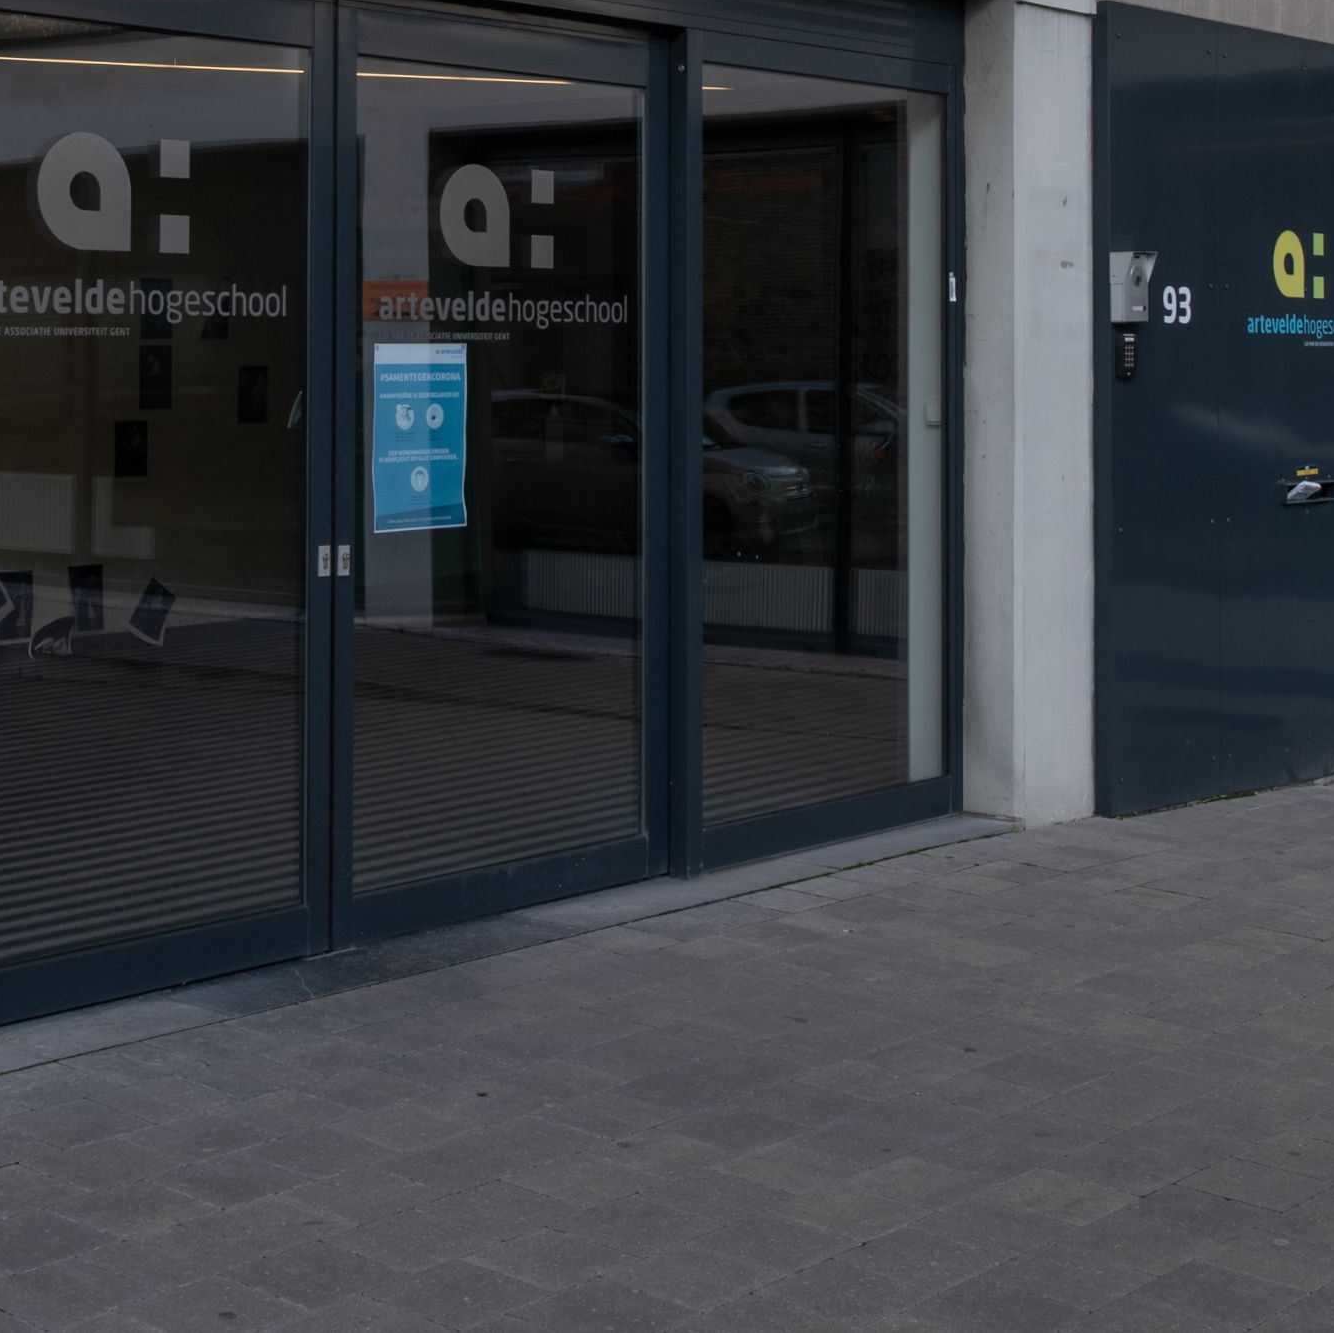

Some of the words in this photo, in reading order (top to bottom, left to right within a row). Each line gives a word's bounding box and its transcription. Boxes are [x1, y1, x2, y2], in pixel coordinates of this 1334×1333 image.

[1162, 285, 1192, 324] 93
[4, 327, 51, 337] ASSOCIATIE
[53, 327, 108, 337] UNIVERSITEIT
[110, 327, 131, 337] GENT
[380, 372, 461, 382] #SAMENTEGENCORONA
